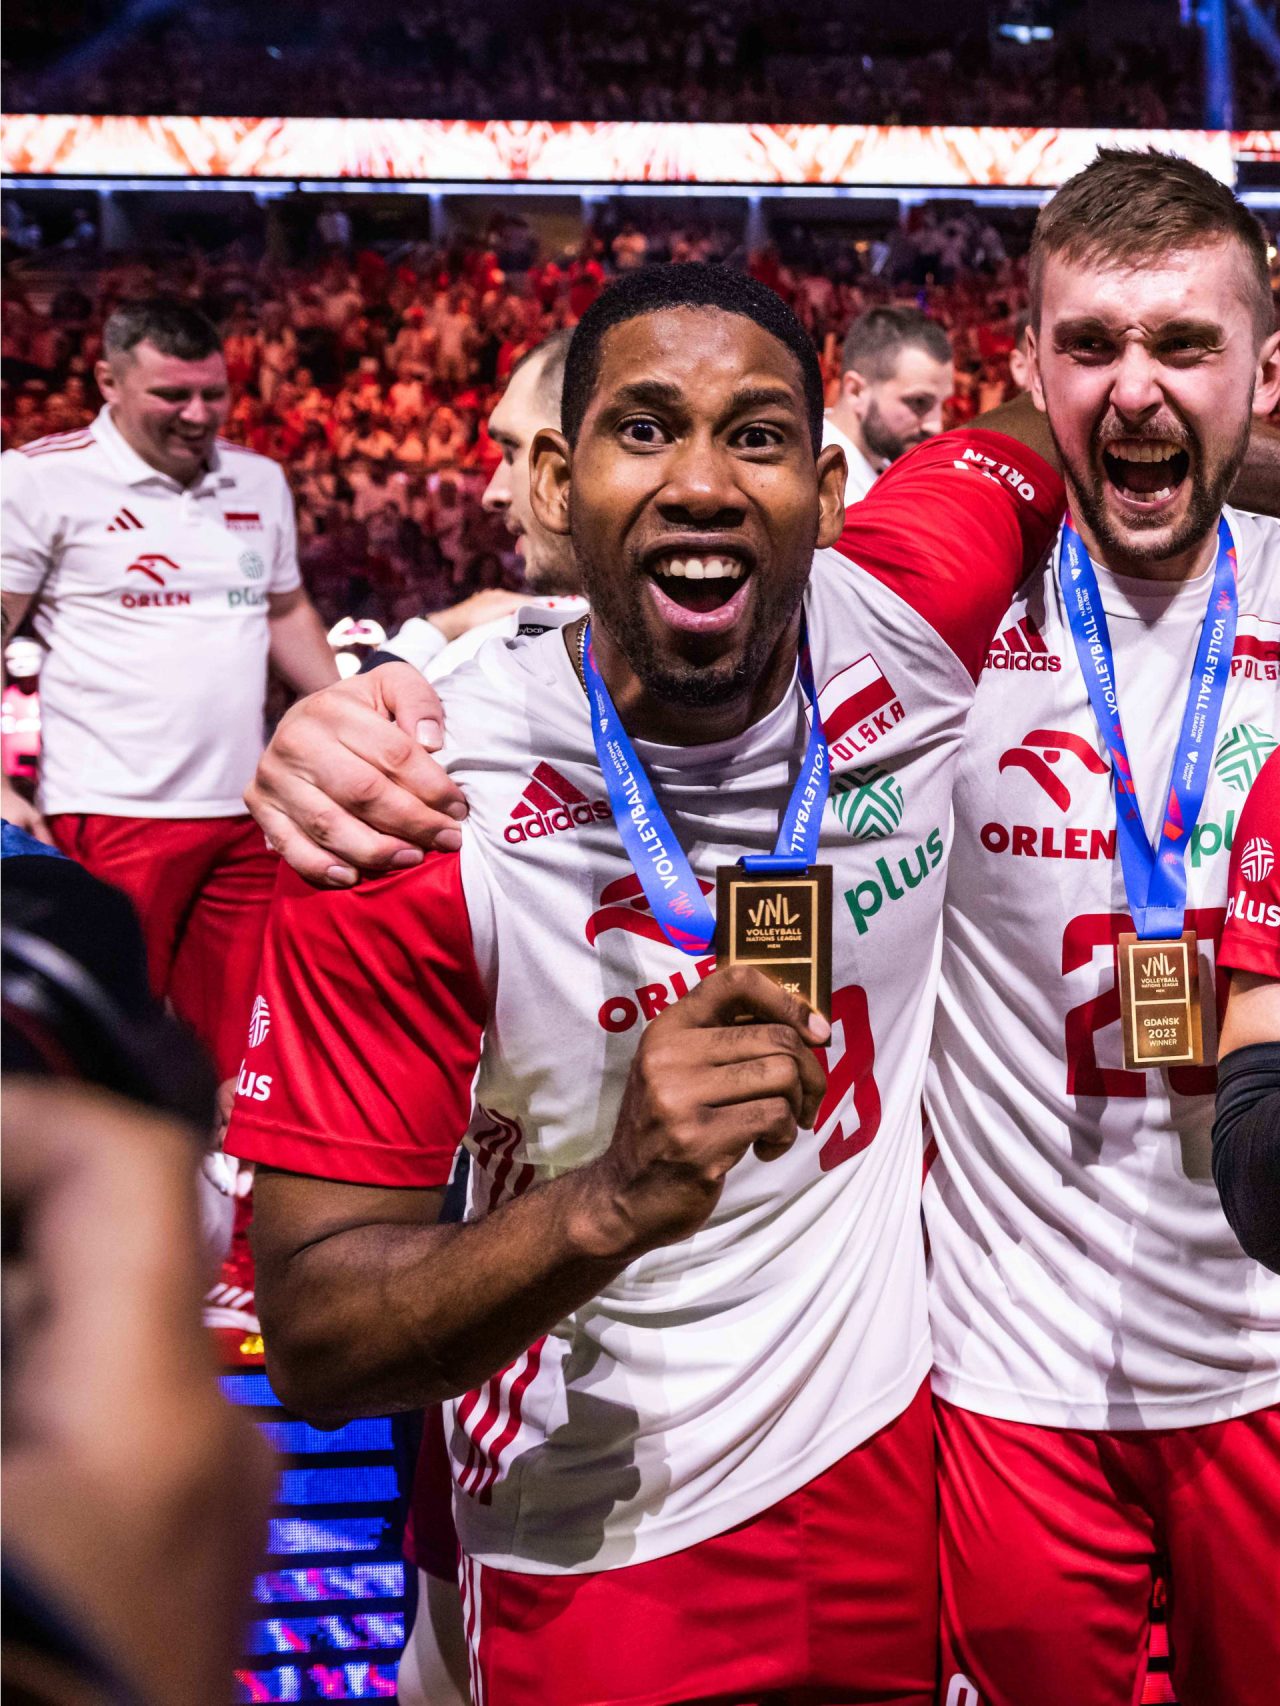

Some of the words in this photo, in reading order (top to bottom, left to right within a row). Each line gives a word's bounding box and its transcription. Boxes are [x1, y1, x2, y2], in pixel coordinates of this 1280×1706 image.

[121, 592, 191, 608] ORLEN
[1075, 587, 1087, 617] NATIONS
[1081, 588, 1093, 614] LEAGUE
[984, 650, 1062, 672] adidas
[1083, 616, 1119, 715] VOLLEYBALL
[1195, 619, 1226, 714] VOLLEYBALL
[1190, 712, 1200, 739] LEAGUE
[1195, 714, 1206, 743] NATIONS
[606, 741, 623, 776] NATIONS
[613, 740, 629, 771] LEAGUE
[790, 743, 825, 852] VOLLEYBALL
[504, 801, 612, 844] adidas
[622, 772, 679, 889] VOLLEYBALL
[1190, 810, 1236, 867] pl
[980, 822, 1116, 860] ORLEN
[843, 827, 944, 936] plus
[748, 893, 800, 927] VNL
[746, 928, 802, 936] VOLLEYBALL
[1142, 953, 1176, 977] VNL
[598, 954, 717, 1033] ORL
[1143, 1016, 1180, 1027] GDAŃSK
[1148, 1028, 1177, 1039] 2023
[1149, 1039, 1178, 1047] WINNER
[236, 1058, 273, 1101] lus
[811, 984, 881, 1172] 9
